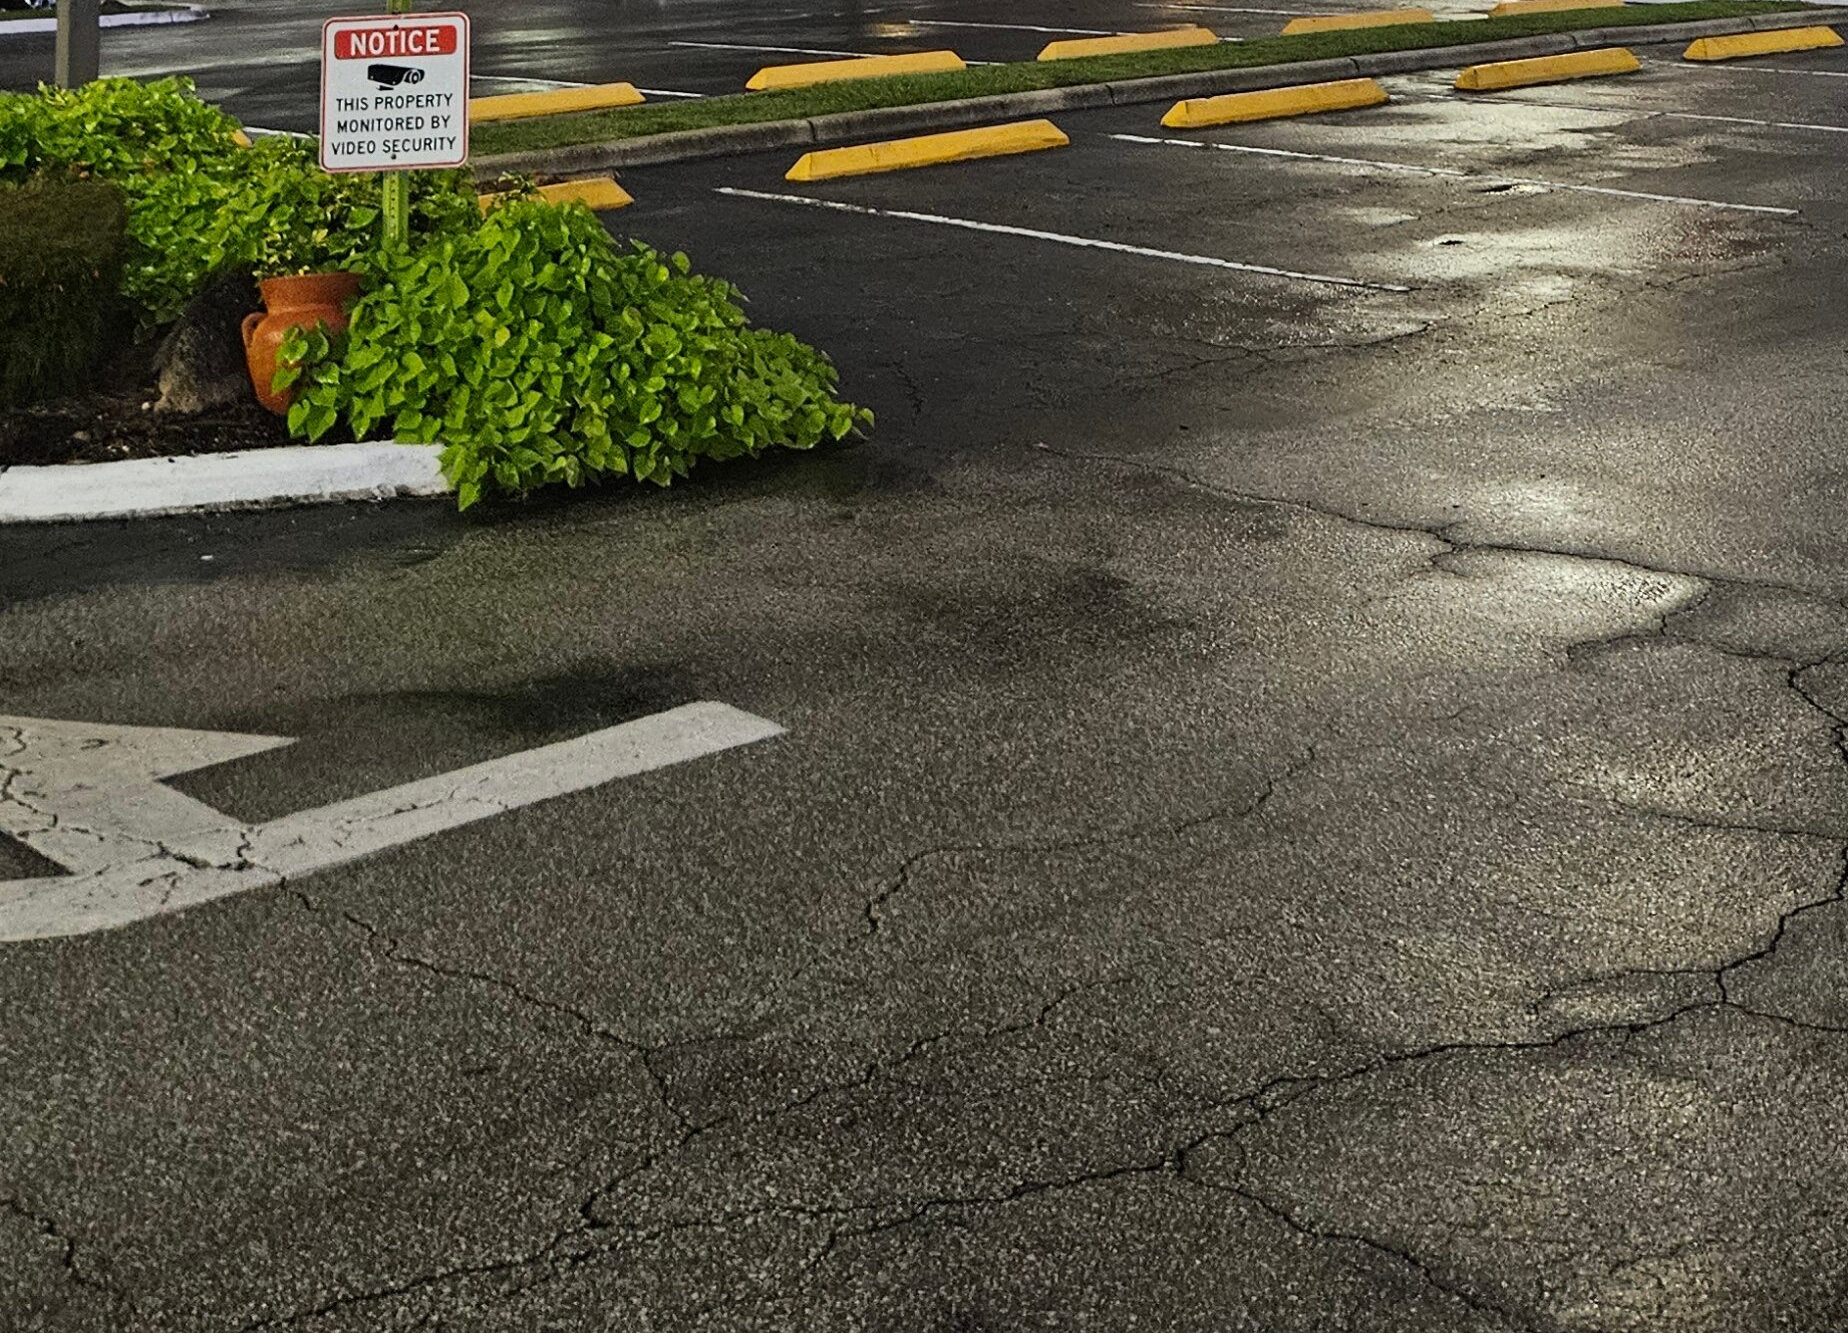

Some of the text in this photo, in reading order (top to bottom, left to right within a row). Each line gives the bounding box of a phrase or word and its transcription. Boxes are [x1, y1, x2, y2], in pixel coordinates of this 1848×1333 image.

[350, 28, 441, 56] NOTICE
[336, 92, 453, 112] THIS PROPERTY
[337, 114, 451, 133] MONITORED BY
[331, 135, 457, 155] VIDEO SECURITY
